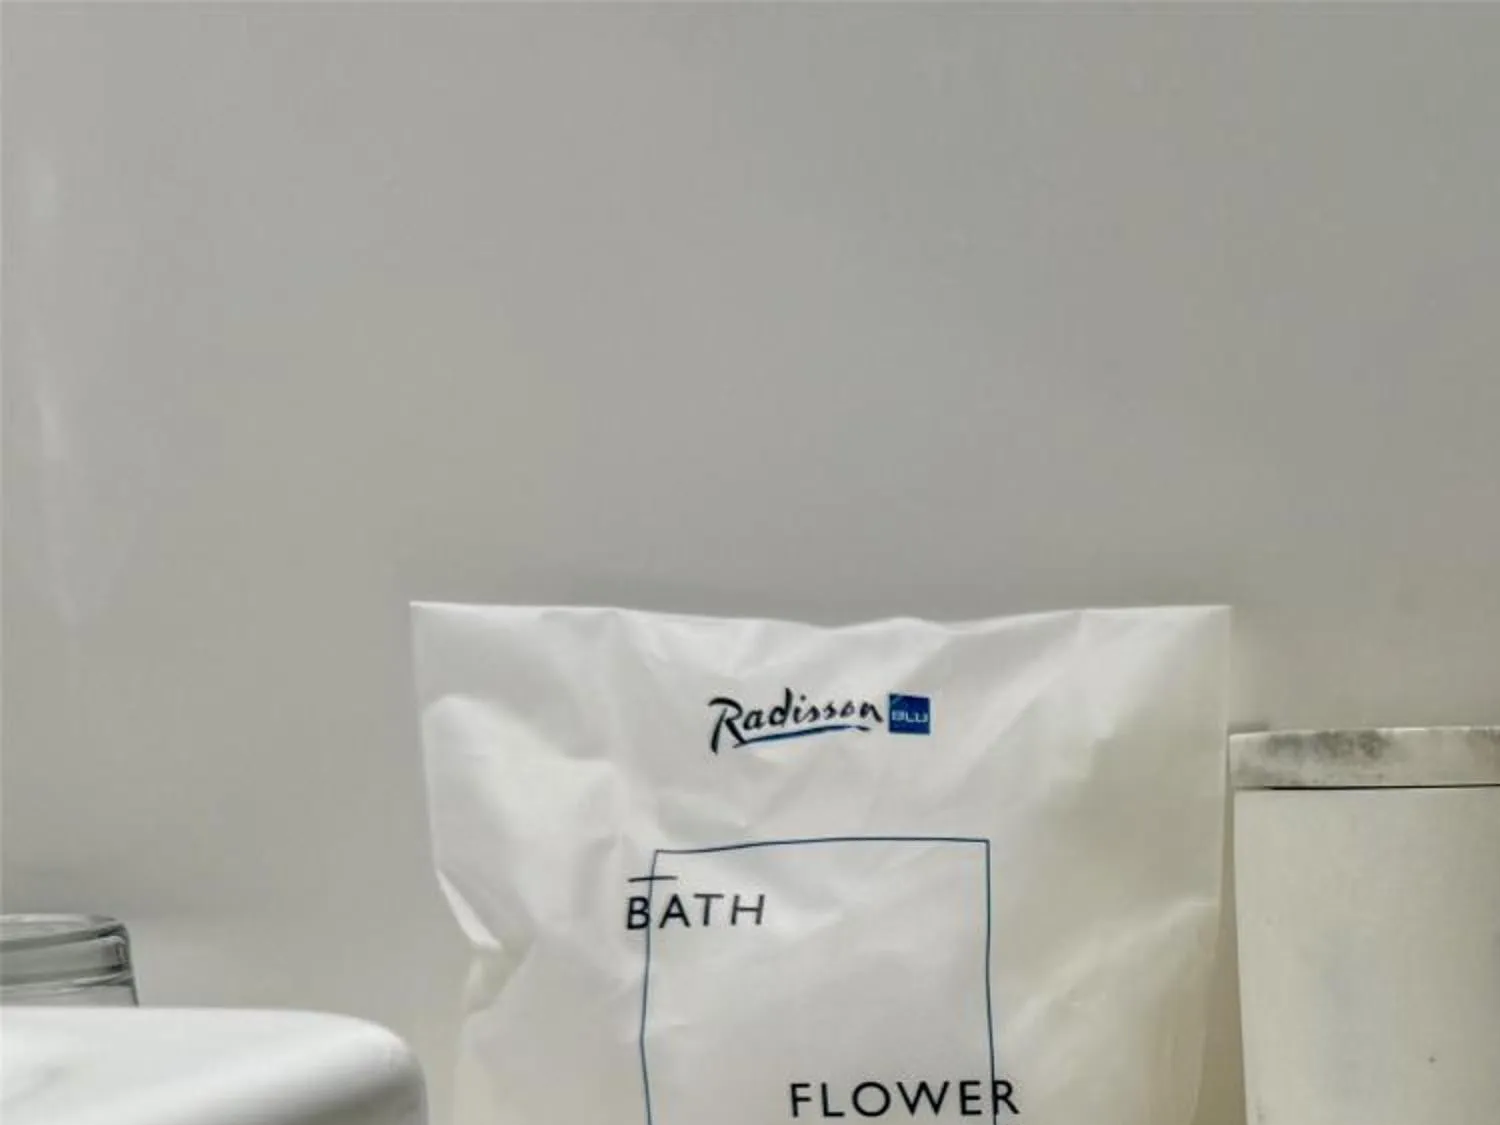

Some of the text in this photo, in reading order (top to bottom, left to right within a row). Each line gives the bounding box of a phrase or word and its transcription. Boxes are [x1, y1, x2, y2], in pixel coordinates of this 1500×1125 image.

[707, 688, 929, 753] Radisson BLU
[627, 892, 766, 930] BATH
[789, 1080, 1020, 1118] FLOWER
